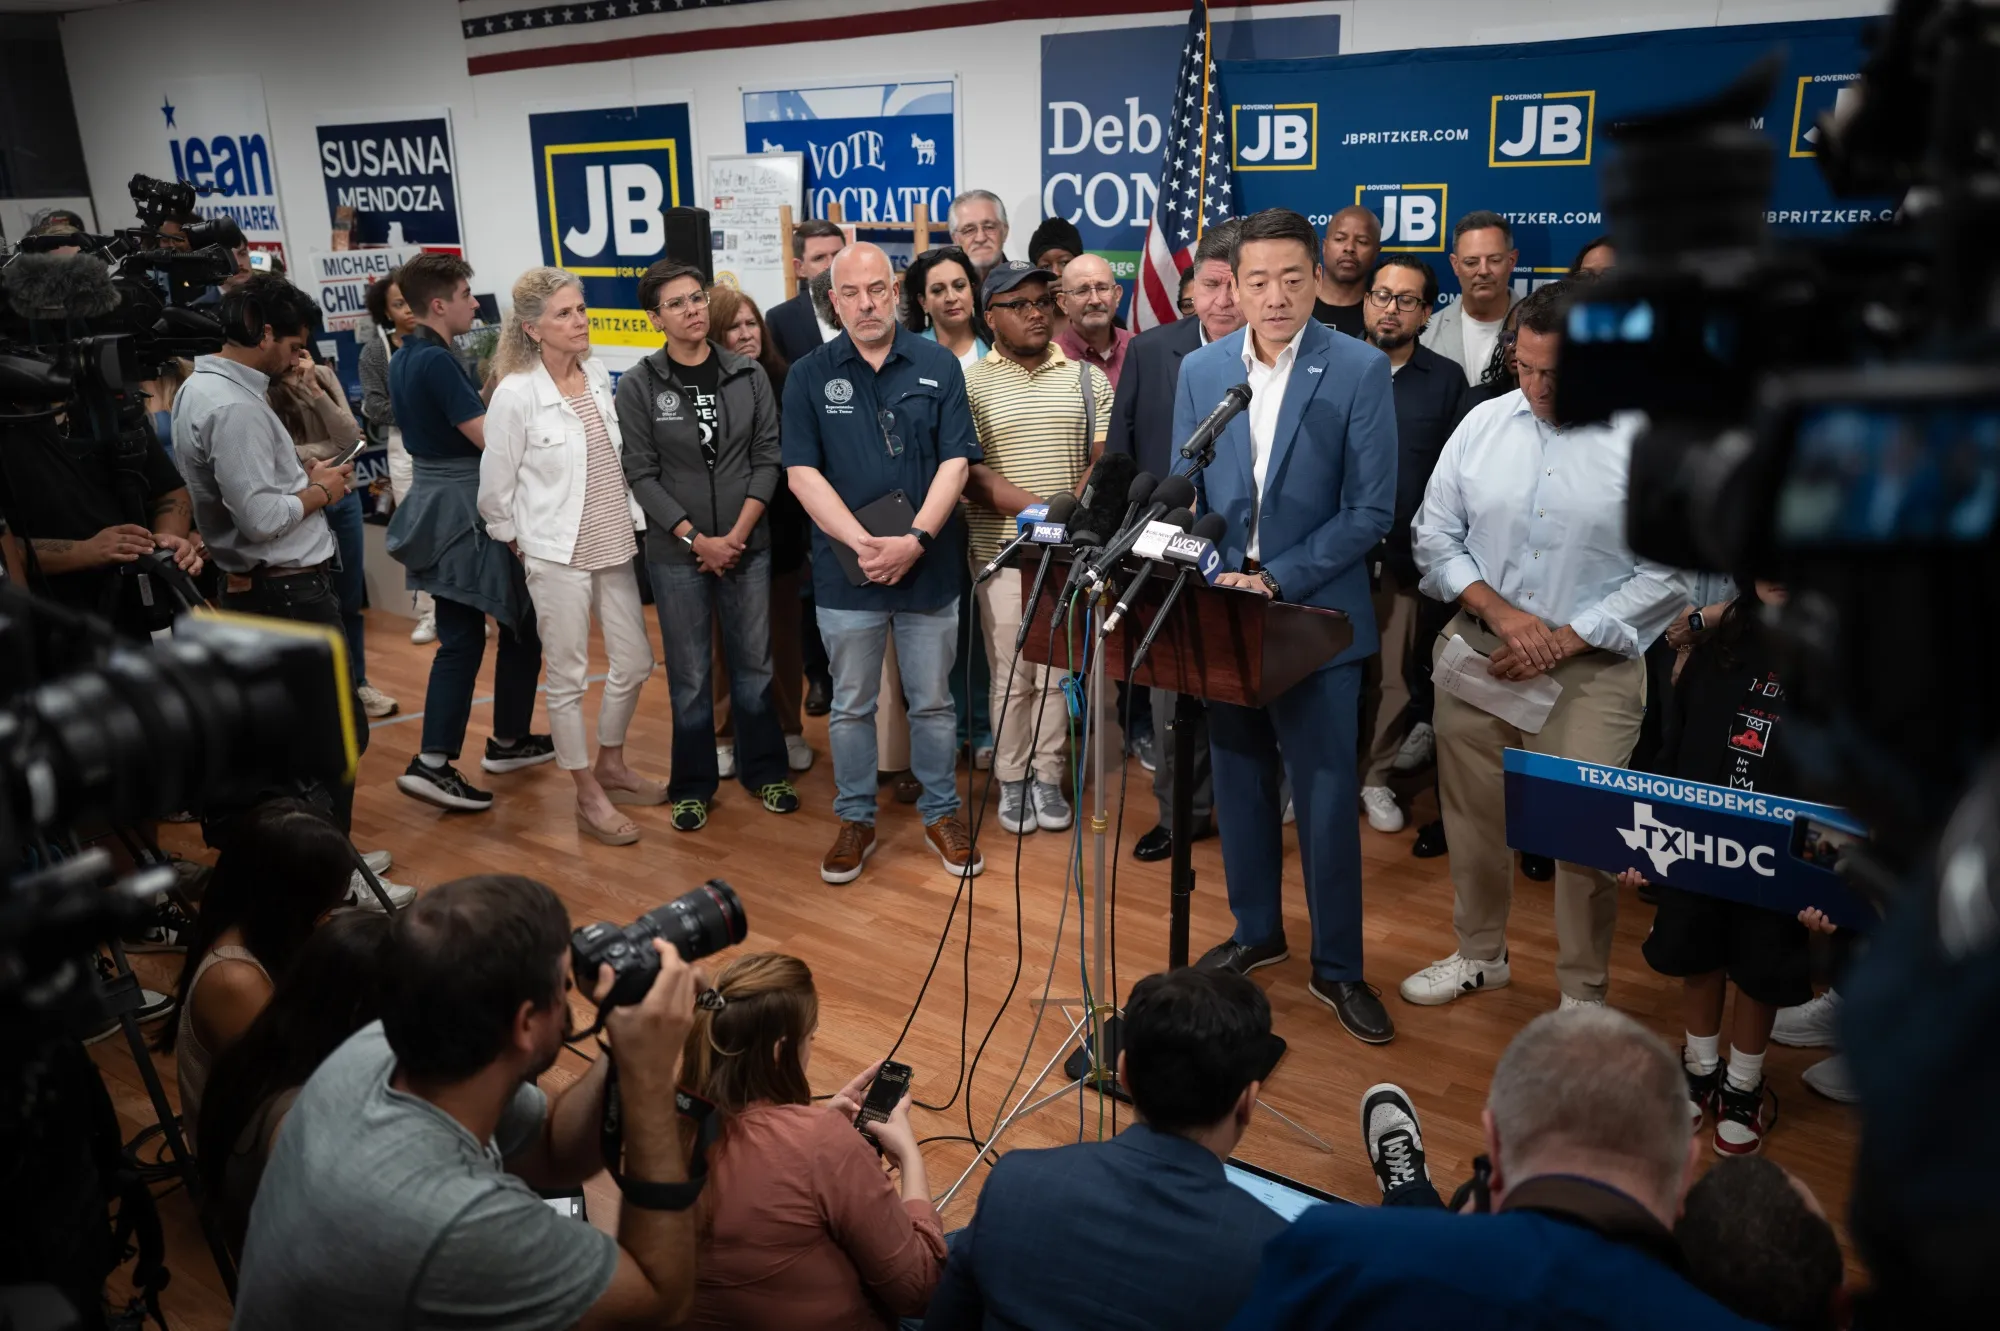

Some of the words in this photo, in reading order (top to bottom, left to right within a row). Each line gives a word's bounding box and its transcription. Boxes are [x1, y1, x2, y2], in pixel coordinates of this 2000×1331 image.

[1504, 93, 1542, 101] GOVERNOR
[1048, 97, 1162, 155] Deb
[1240, 115, 1308, 161] JB
[1342, 128, 1469, 145] JBPRITZKER.COM
[1499, 104, 1582, 156] JB
[322, 135, 450, 177] SUSANA
[807, 130, 886, 180] VOTE
[338, 185, 444, 212] MENDOZA
[564, 163, 666, 258] JB
[1380, 195, 1436, 242] JB
[1500, 212, 1601, 225] ITZKER.COM
[323, 253, 396, 277] MICHAEL
[1105, 259, 1136, 277] age
[322, 284, 368, 313] CHIL
[1035, 526, 1052, 536] FOX
[1052, 527, 1063, 536] 32
[1172, 535, 1206, 553] WGN
[1202, 550, 1220, 577] 9
